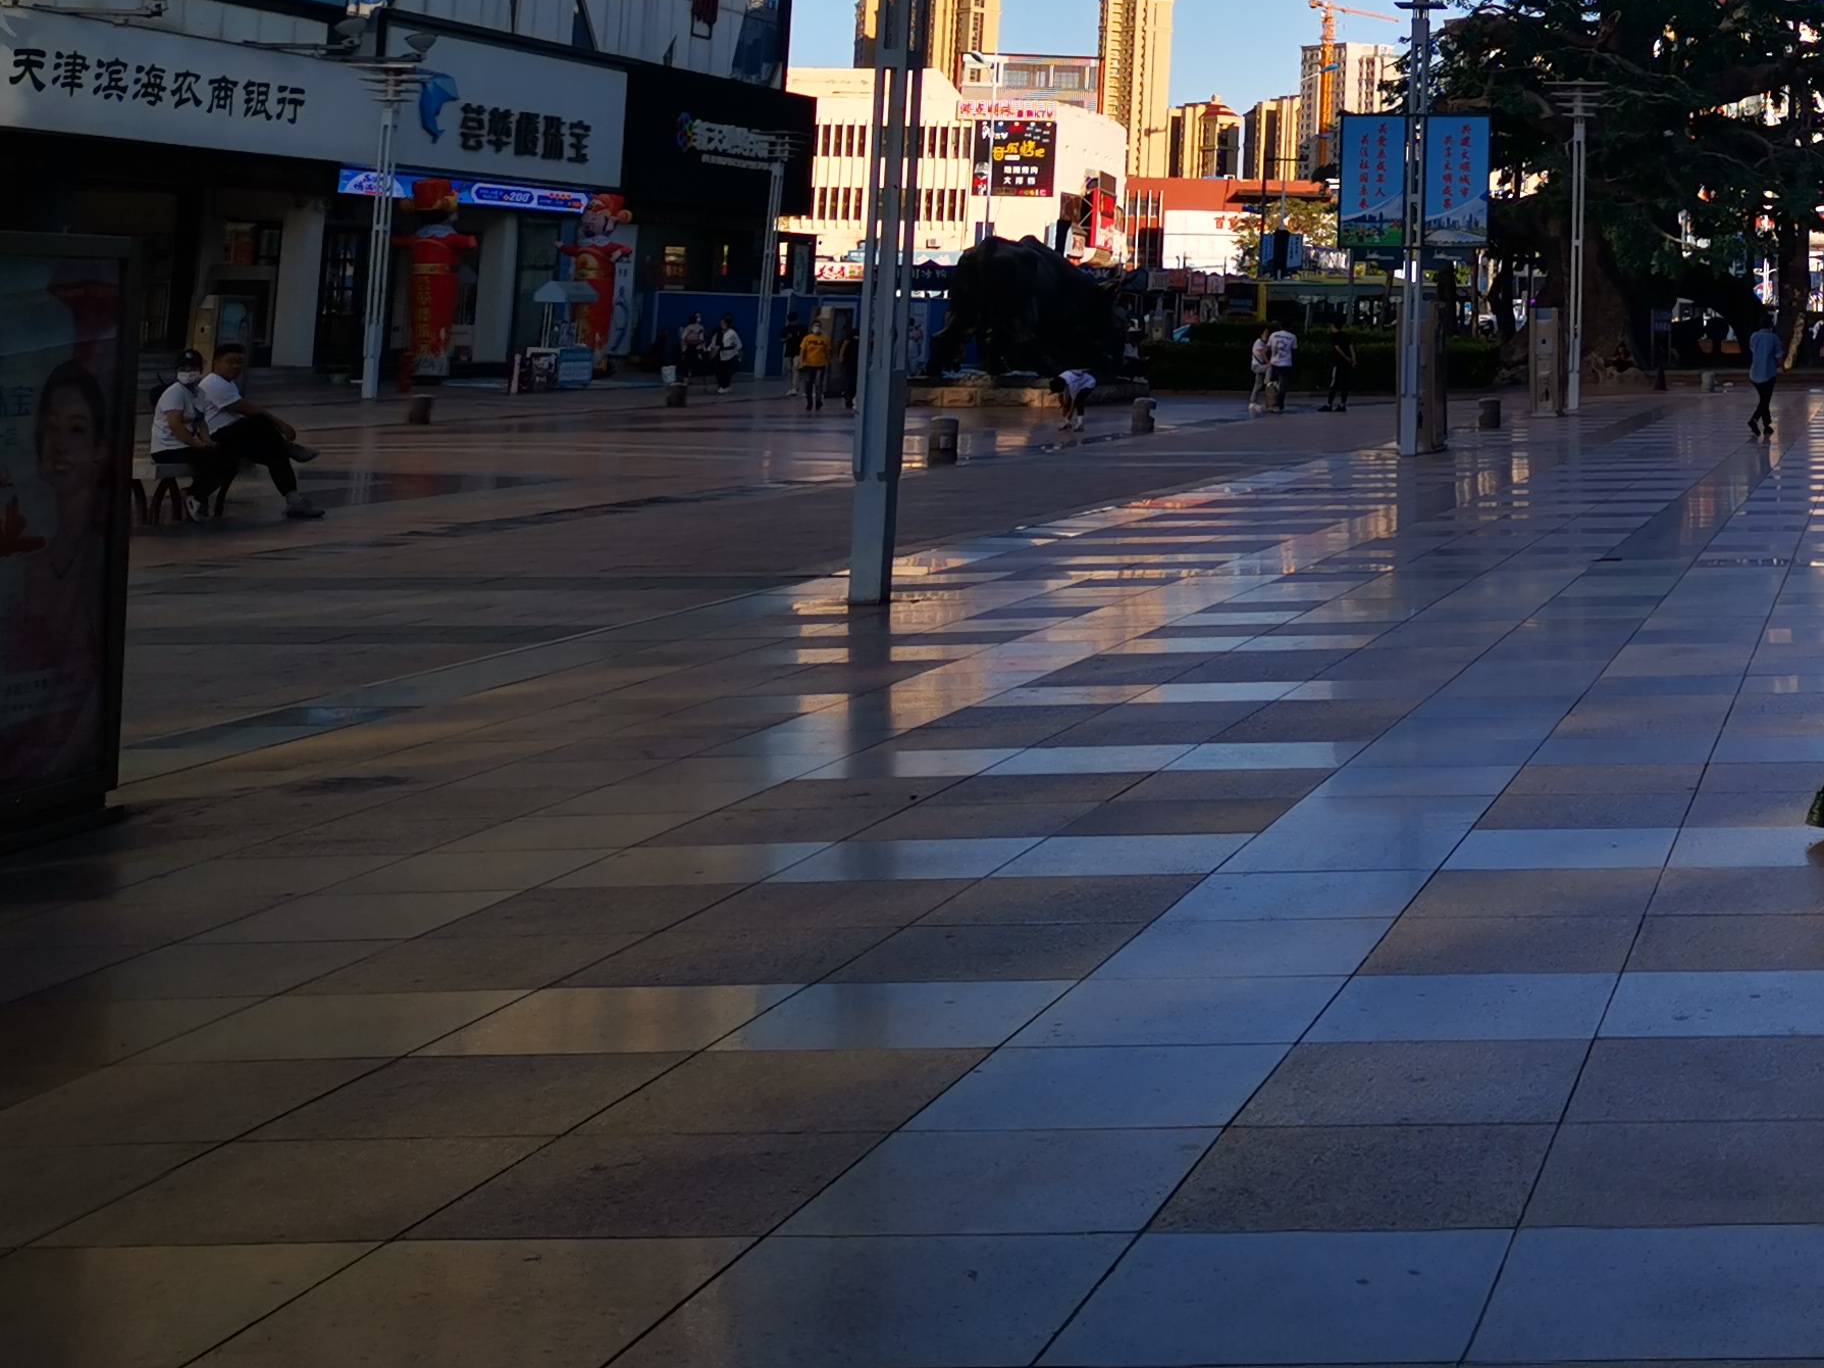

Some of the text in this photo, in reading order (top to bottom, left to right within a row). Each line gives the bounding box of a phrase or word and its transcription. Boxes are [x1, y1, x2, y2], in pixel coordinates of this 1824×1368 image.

[8, 48, 307, 125] 天津滨海农商银行
